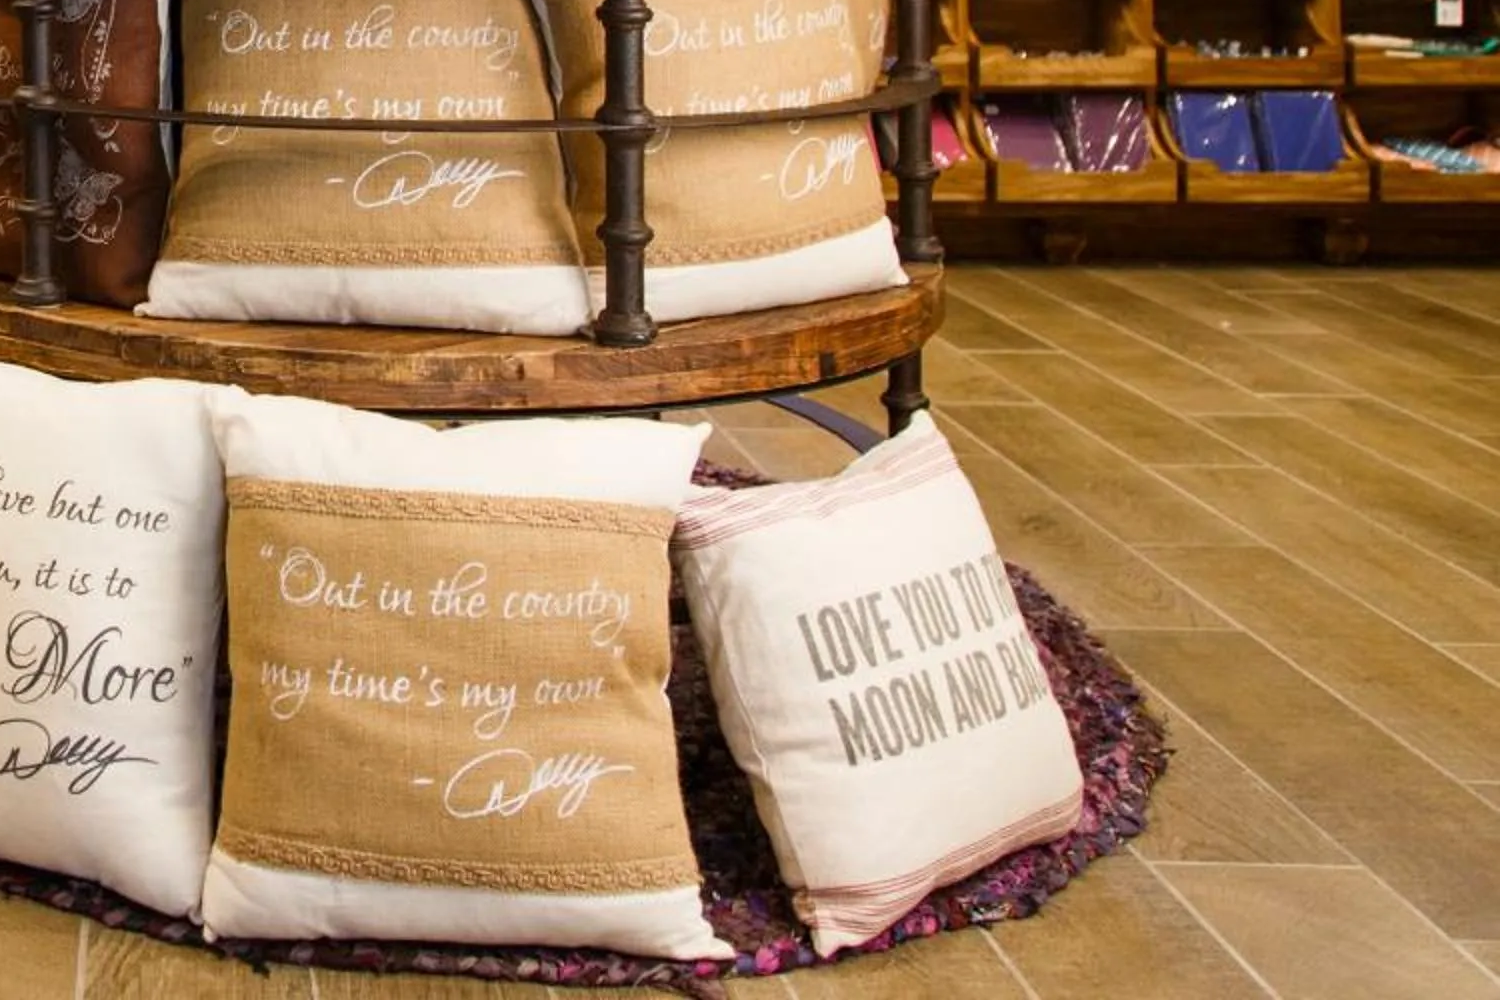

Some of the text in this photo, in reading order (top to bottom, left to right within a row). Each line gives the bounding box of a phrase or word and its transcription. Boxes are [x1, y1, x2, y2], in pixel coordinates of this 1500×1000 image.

[302, 27, 331, 51] in
[345, 4, 393, 49] the
[407, 18, 519, 70] country
[720, 20, 747, 48] in
[259, 89, 356, 120] time's
[46, 480, 105, 526] but
[115, 506, 171, 534] one
[34, 559, 60, 591] it
[67, 567, 92, 597] is
[105, 567, 138, 600] to
[379, 580, 415, 615] in
[429, 561, 490, 619] the
[503, 577, 631, 647] country
[796, 591, 905, 682] LOVE
[890, 573, 961, 652] YOU
[948, 560, 995, 633] TO
[260, 660, 312, 720] my
[327, 657, 448, 708] time's
[461, 679, 517, 740] my
[828, 668, 949, 767] MOON
[942, 649, 1007, 734] AND
